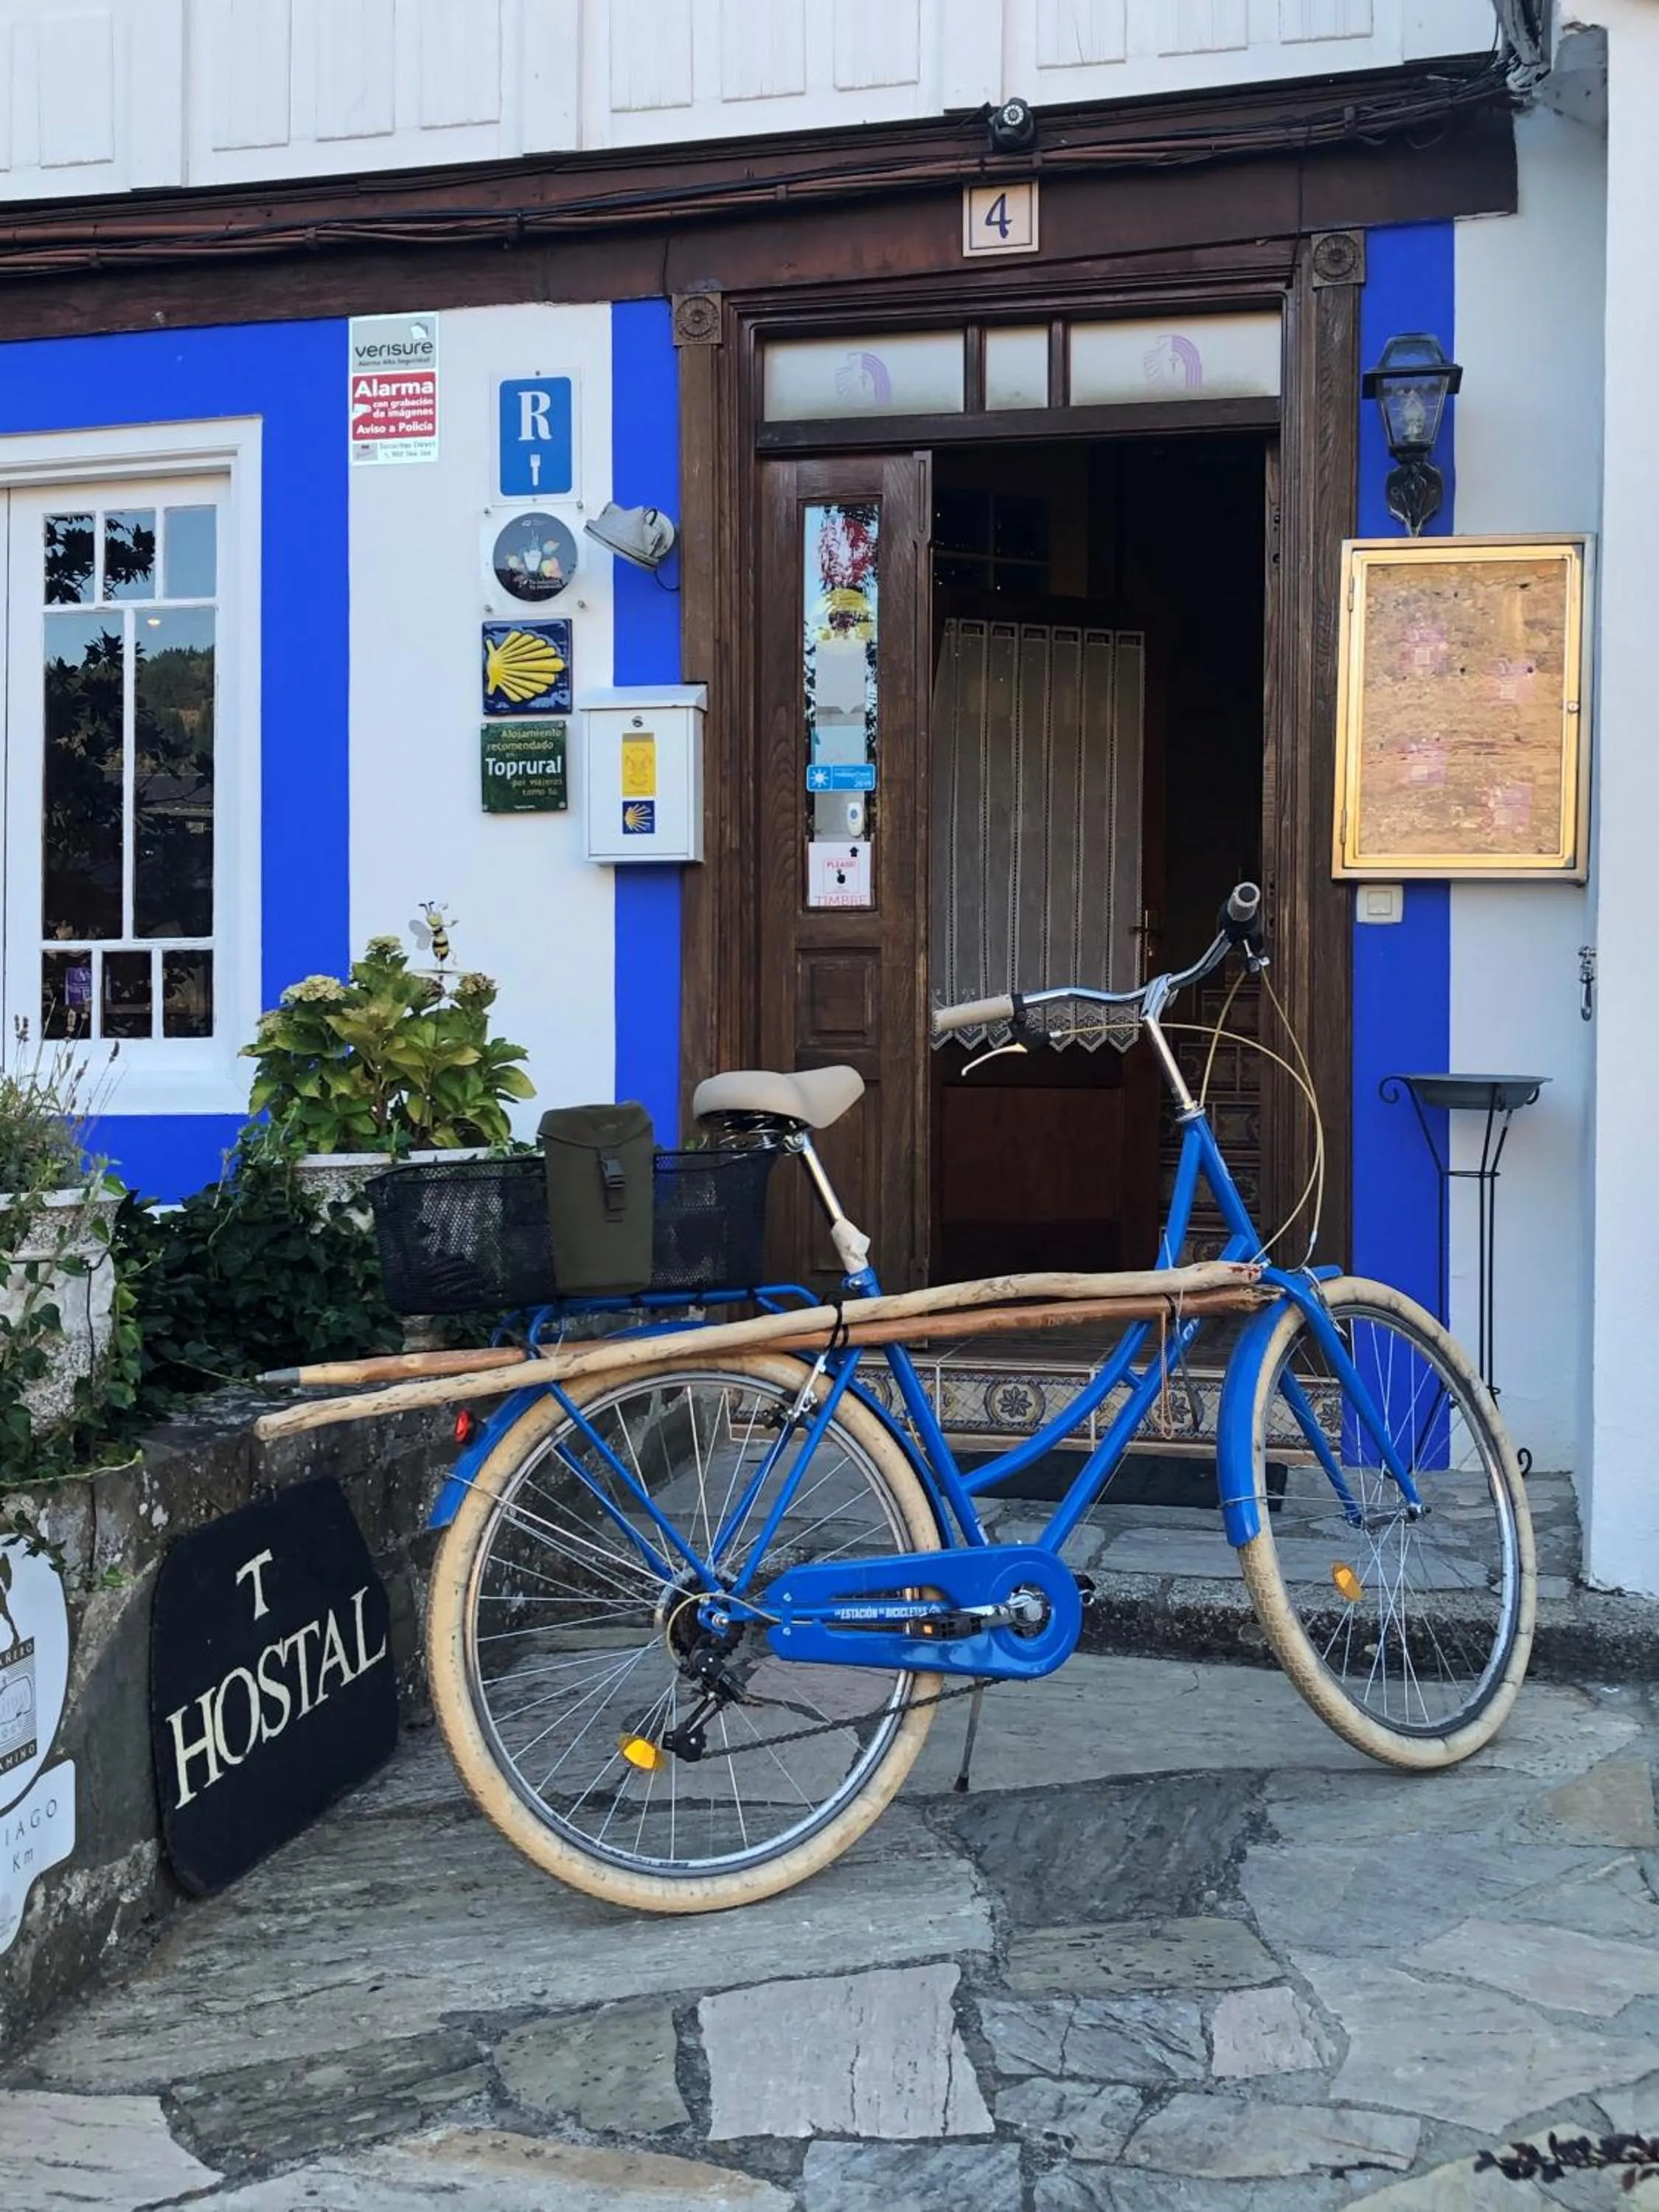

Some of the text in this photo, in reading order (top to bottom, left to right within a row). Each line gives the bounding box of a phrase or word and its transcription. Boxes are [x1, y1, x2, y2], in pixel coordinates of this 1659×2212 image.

[985, 192, 1012, 239] 4
[355, 341, 434, 358] verisure
[355, 378, 434, 397] Alarma
[390, 397, 434, 408] grabación
[373, 408, 434, 419] de imágenes
[518, 392, 552, 441] R
[356, 420, 433, 434] Aviso a Policía
[487, 740, 554, 751] recomendado
[485, 755, 562, 780] Toprural
[813, 894, 866, 906] TIMBRE
[166, 1586, 386, 1809] HOSTAL
